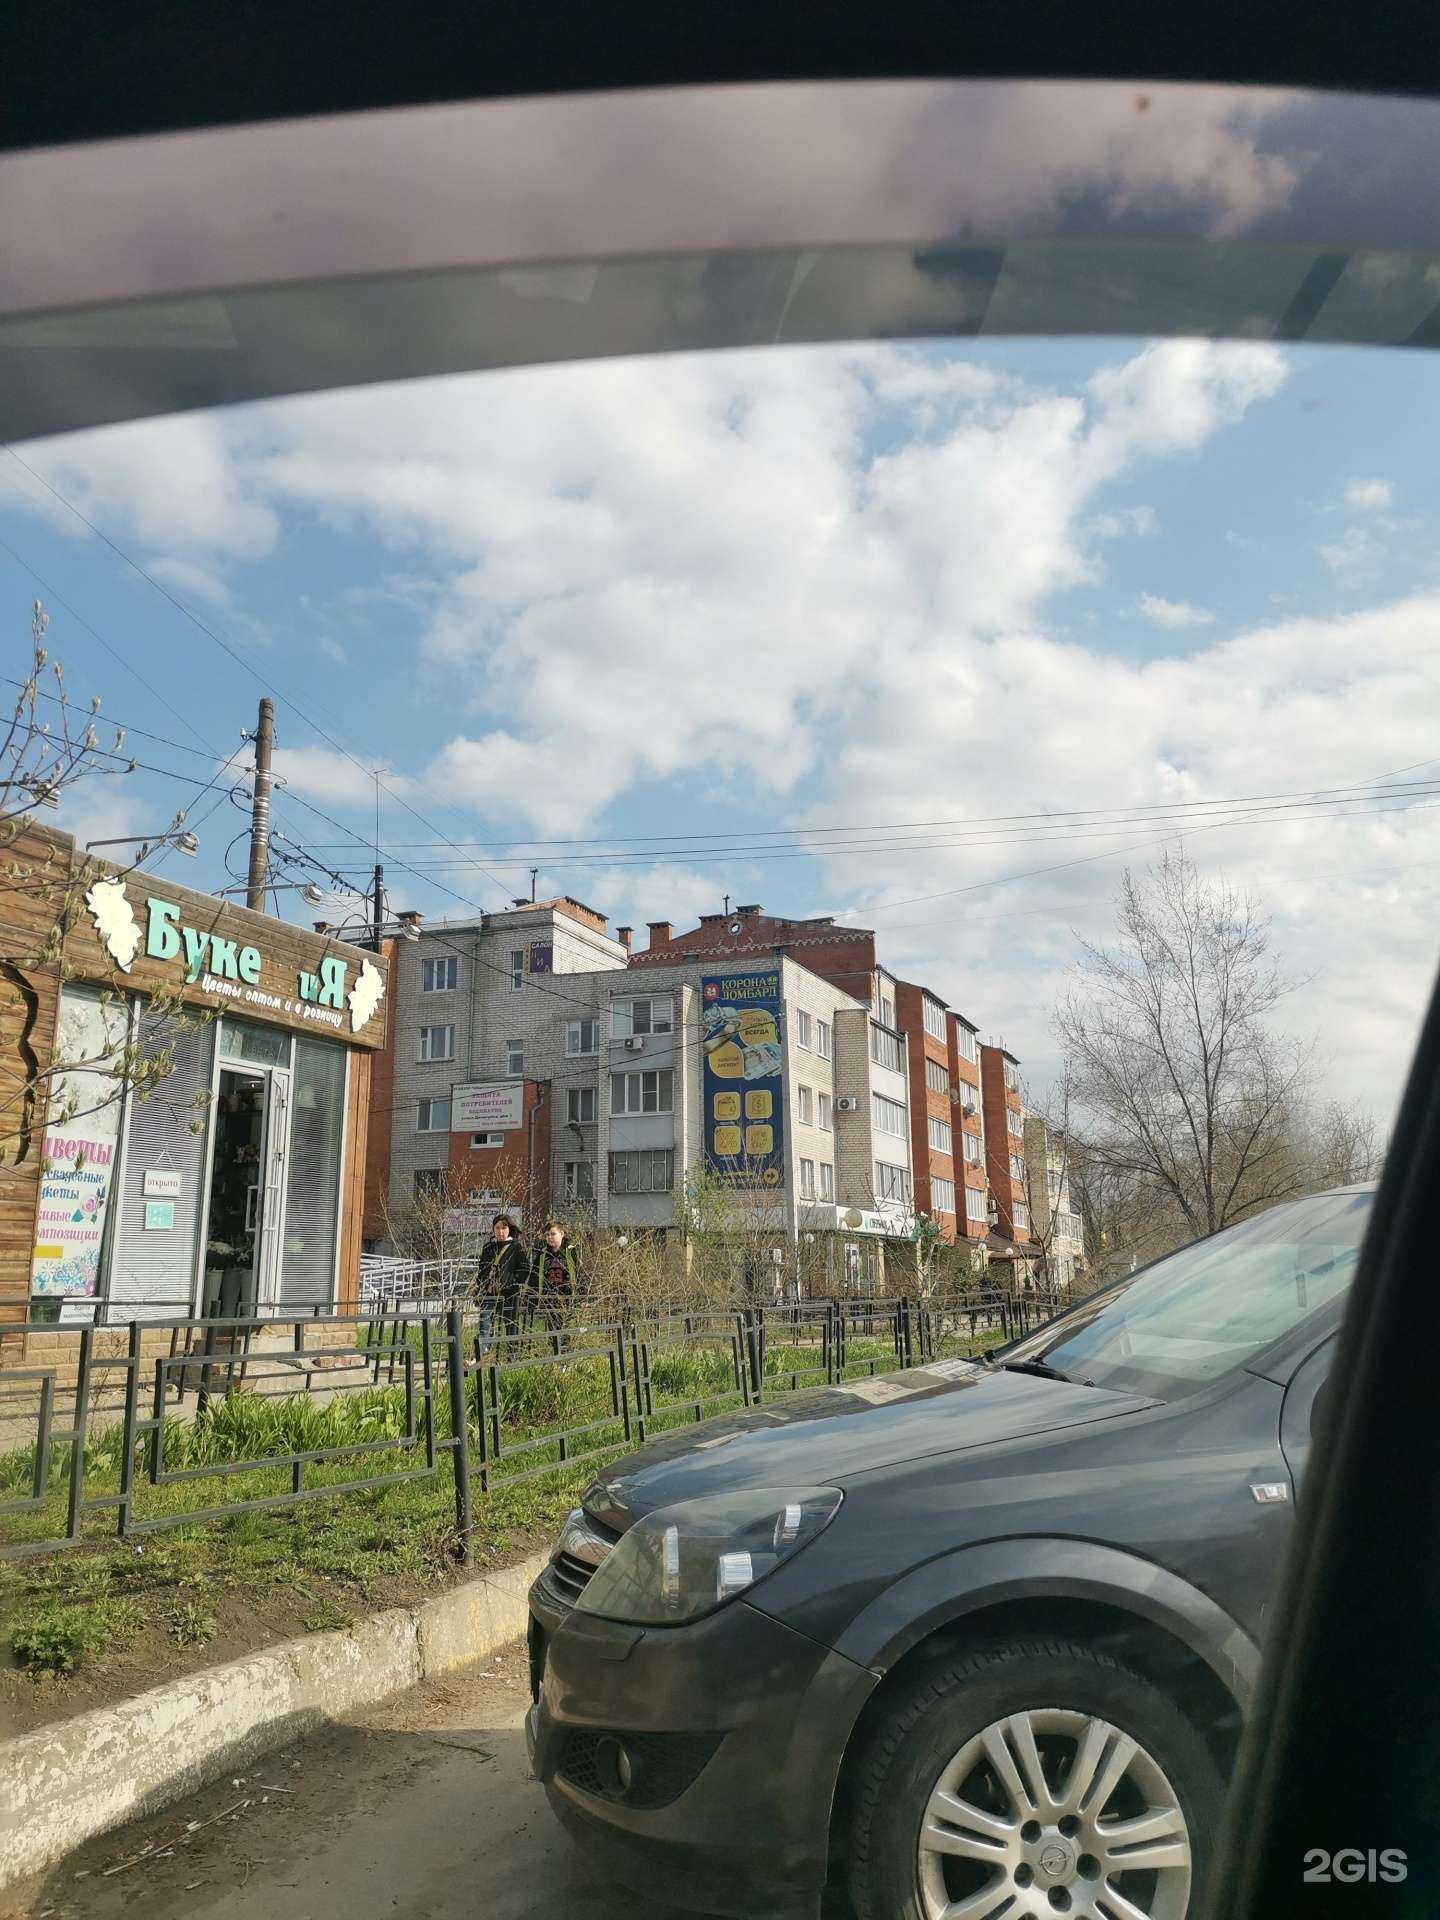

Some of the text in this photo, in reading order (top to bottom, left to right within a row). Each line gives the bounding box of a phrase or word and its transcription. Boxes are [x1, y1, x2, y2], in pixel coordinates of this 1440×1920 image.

[722, 977, 767, 989] КОРОНА
[723, 987, 776, 1000] ЛОМБАРД
[202, 973, 242, 998] Цветы
[246, 989, 281, 1009] оптом
[285, 1000, 291, 1012] и
[303, 1004, 343, 1028] розницу
